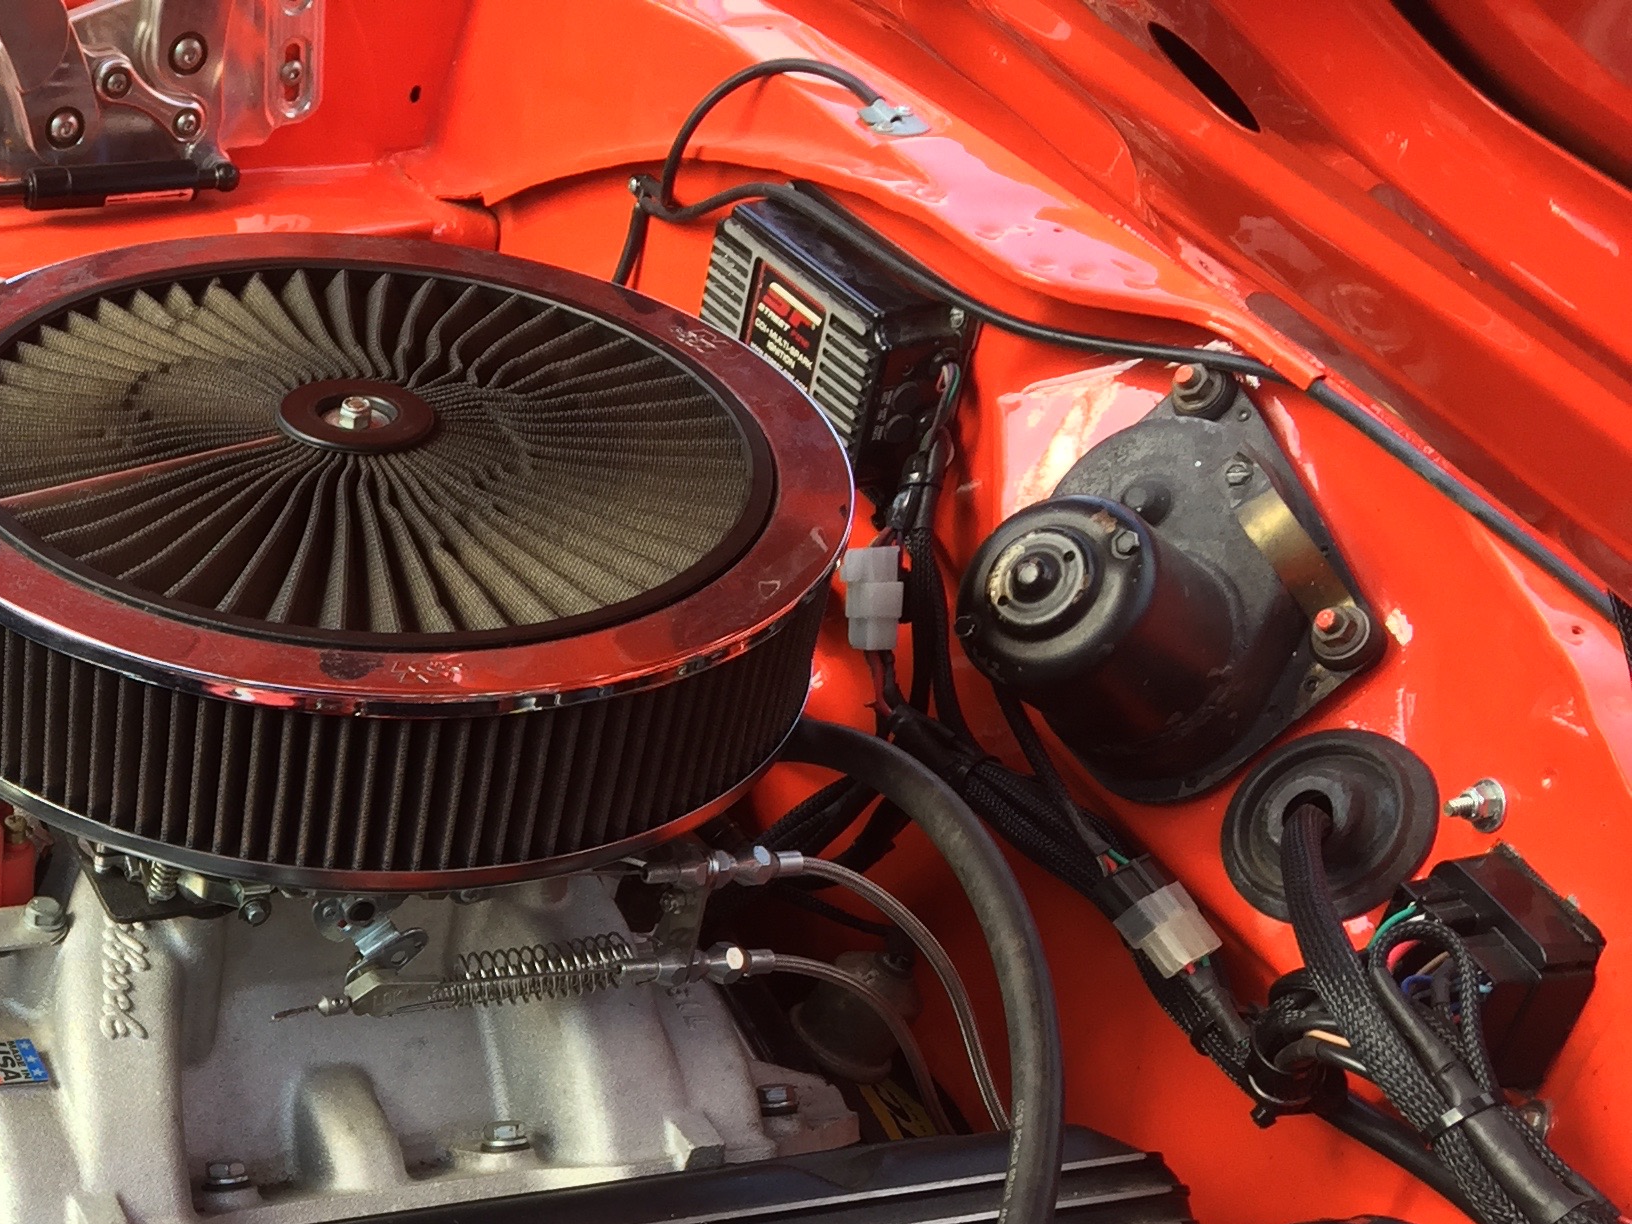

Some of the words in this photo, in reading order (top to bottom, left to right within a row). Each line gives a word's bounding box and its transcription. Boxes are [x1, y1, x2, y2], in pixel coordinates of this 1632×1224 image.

[757, 302, 791, 332] STREET
[7, 1040, 27, 1067] MADE
[21, 1066, 33, 1080] IN
